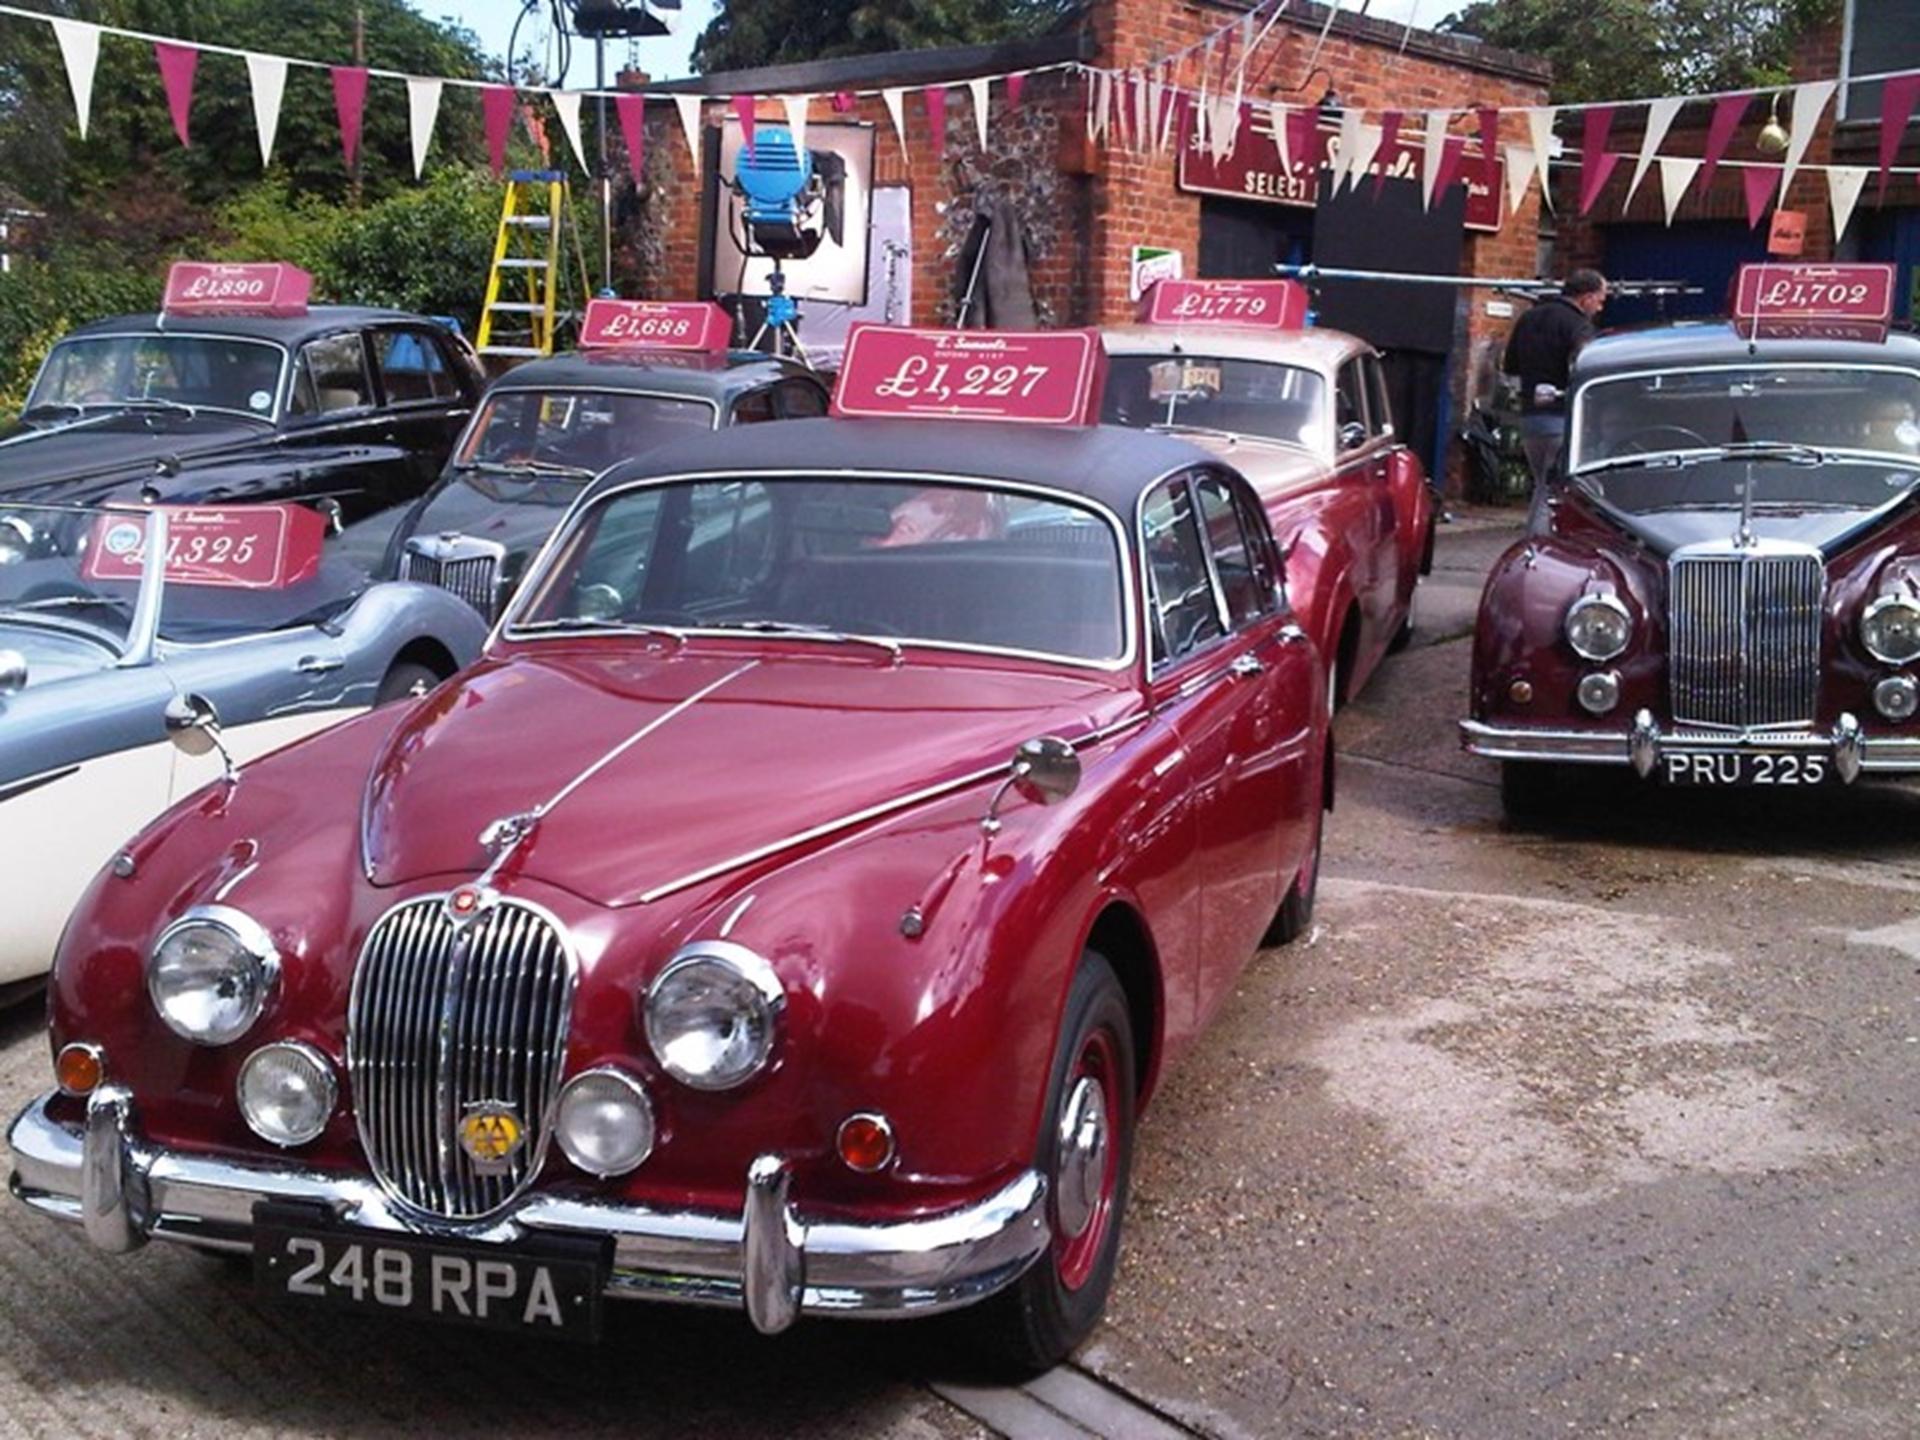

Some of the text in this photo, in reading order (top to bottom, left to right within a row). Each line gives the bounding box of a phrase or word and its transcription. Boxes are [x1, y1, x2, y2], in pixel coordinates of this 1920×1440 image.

[182, 276, 264, 298] £1,890
[1760, 280, 1868, 307] £1,702
[1172, 293, 1267, 317] £1,779
[600, 314, 691, 338] £1,688
[875, 355, 1049, 401] £1,227
[1665, 754, 1828, 784] PRU 225
[286, 1237, 563, 1326] 248 RPA
